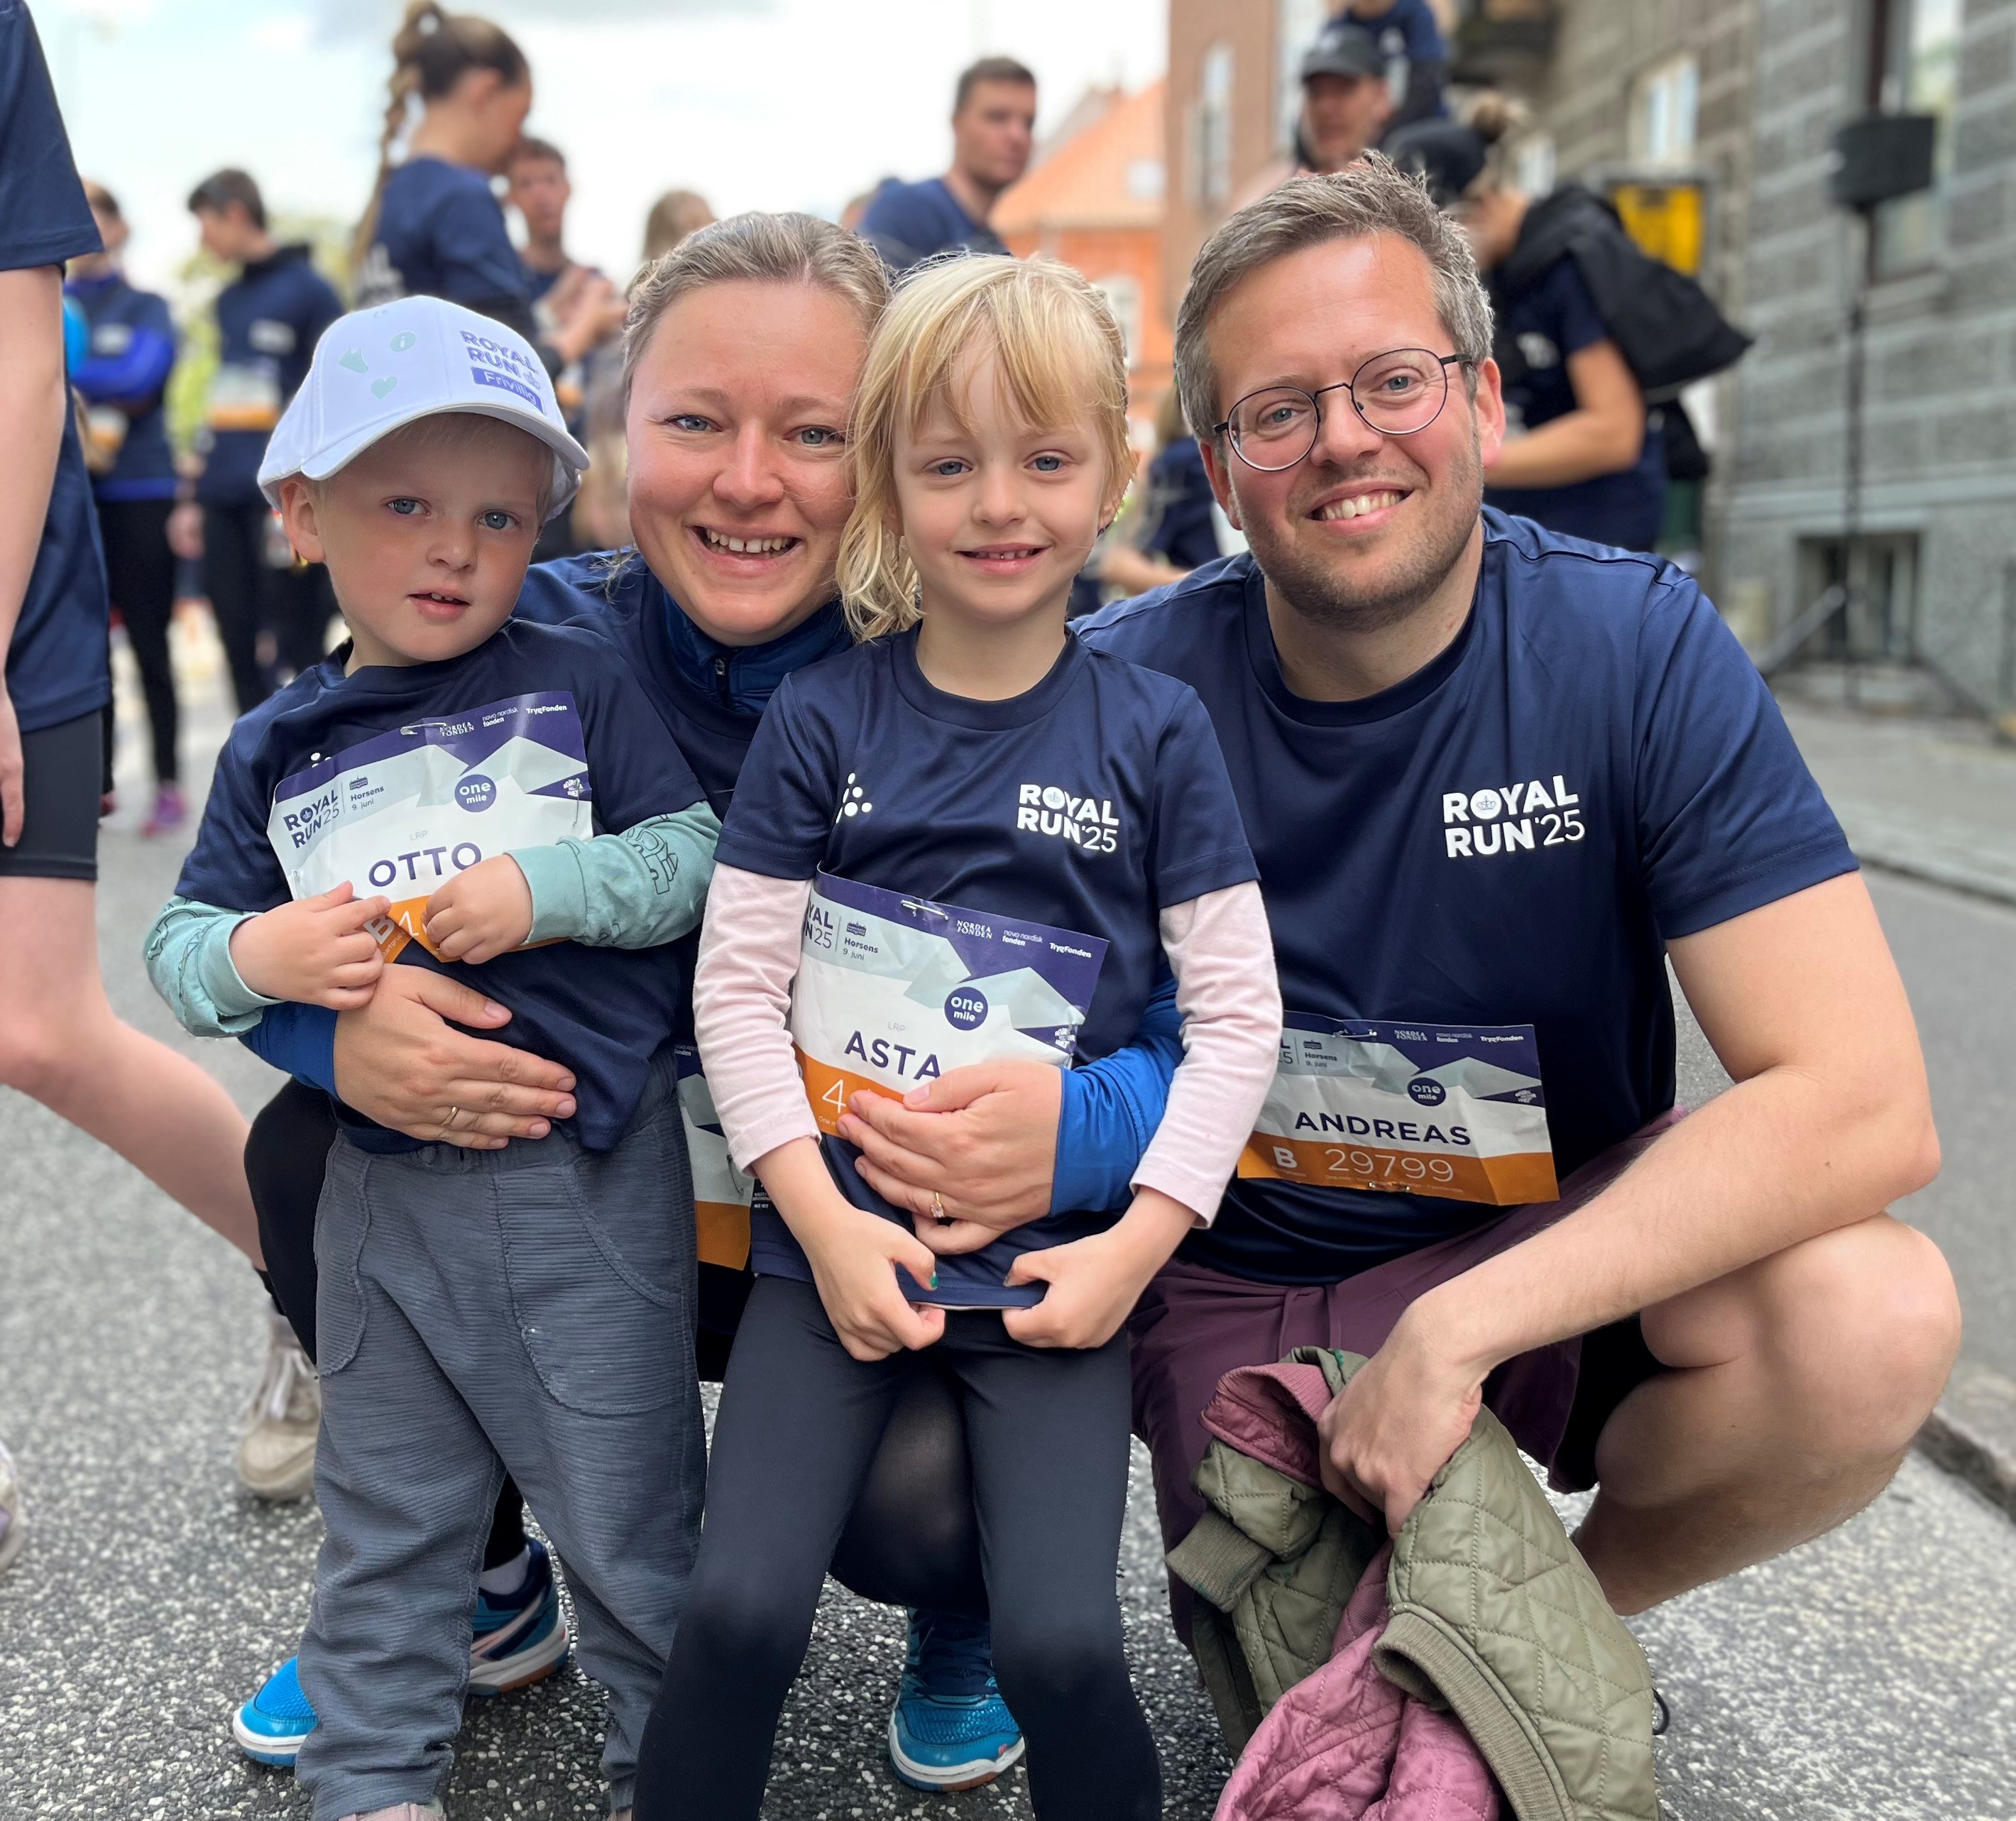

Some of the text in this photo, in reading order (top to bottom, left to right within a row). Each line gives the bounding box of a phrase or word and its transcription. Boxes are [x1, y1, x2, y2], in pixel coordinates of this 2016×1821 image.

[459, 330, 539, 375] ROYAL
[466, 346, 522, 378] RUN
[483, 369, 537, 406] Frivillig
[482, 706, 519, 722] novo nordisk
[526, 704, 567, 715] TrygFonden
[483, 717, 505, 728] fonden
[350, 786, 385, 802] Horsens
[459, 782, 491, 796] one
[361, 798, 375, 810] juni
[466, 794, 488, 804] mile
[1019, 784, 1119, 826] ROYAL
[1442, 775, 1579, 824] ROYAL
[283, 789, 339, 831] ROYAL
[410, 830, 428, 841] LRP
[368, 842, 482, 887] OTTO
[808, 899, 833, 930] YAL
[363, 913, 396, 945] B
[956, 919, 991, 934] NORDEA
[957, 926, 993, 939] FONDEN
[1002, 934, 1026, 946] fonden
[1003, 929, 1043, 944] novo nordisk
[844, 937, 880, 953] Horsens
[1049, 942, 1092, 958] TrygFonden
[850, 951, 865, 961] juni
[951, 995, 984, 1013] one
[953, 1011, 976, 1022] mile
[887, 1021, 906, 1032] LRP
[1480, 1034, 1524, 1043] TrygFonden
[843, 1029, 941, 1081] ASTA
[1305, 1051, 1338, 1061] Horsens
[1411, 1083, 1441, 1094] one
[1295, 1111, 1472, 1146] ANDREAS
[1273, 1146, 1298, 1169] B
[1325, 1148, 1454, 1183] 29799
